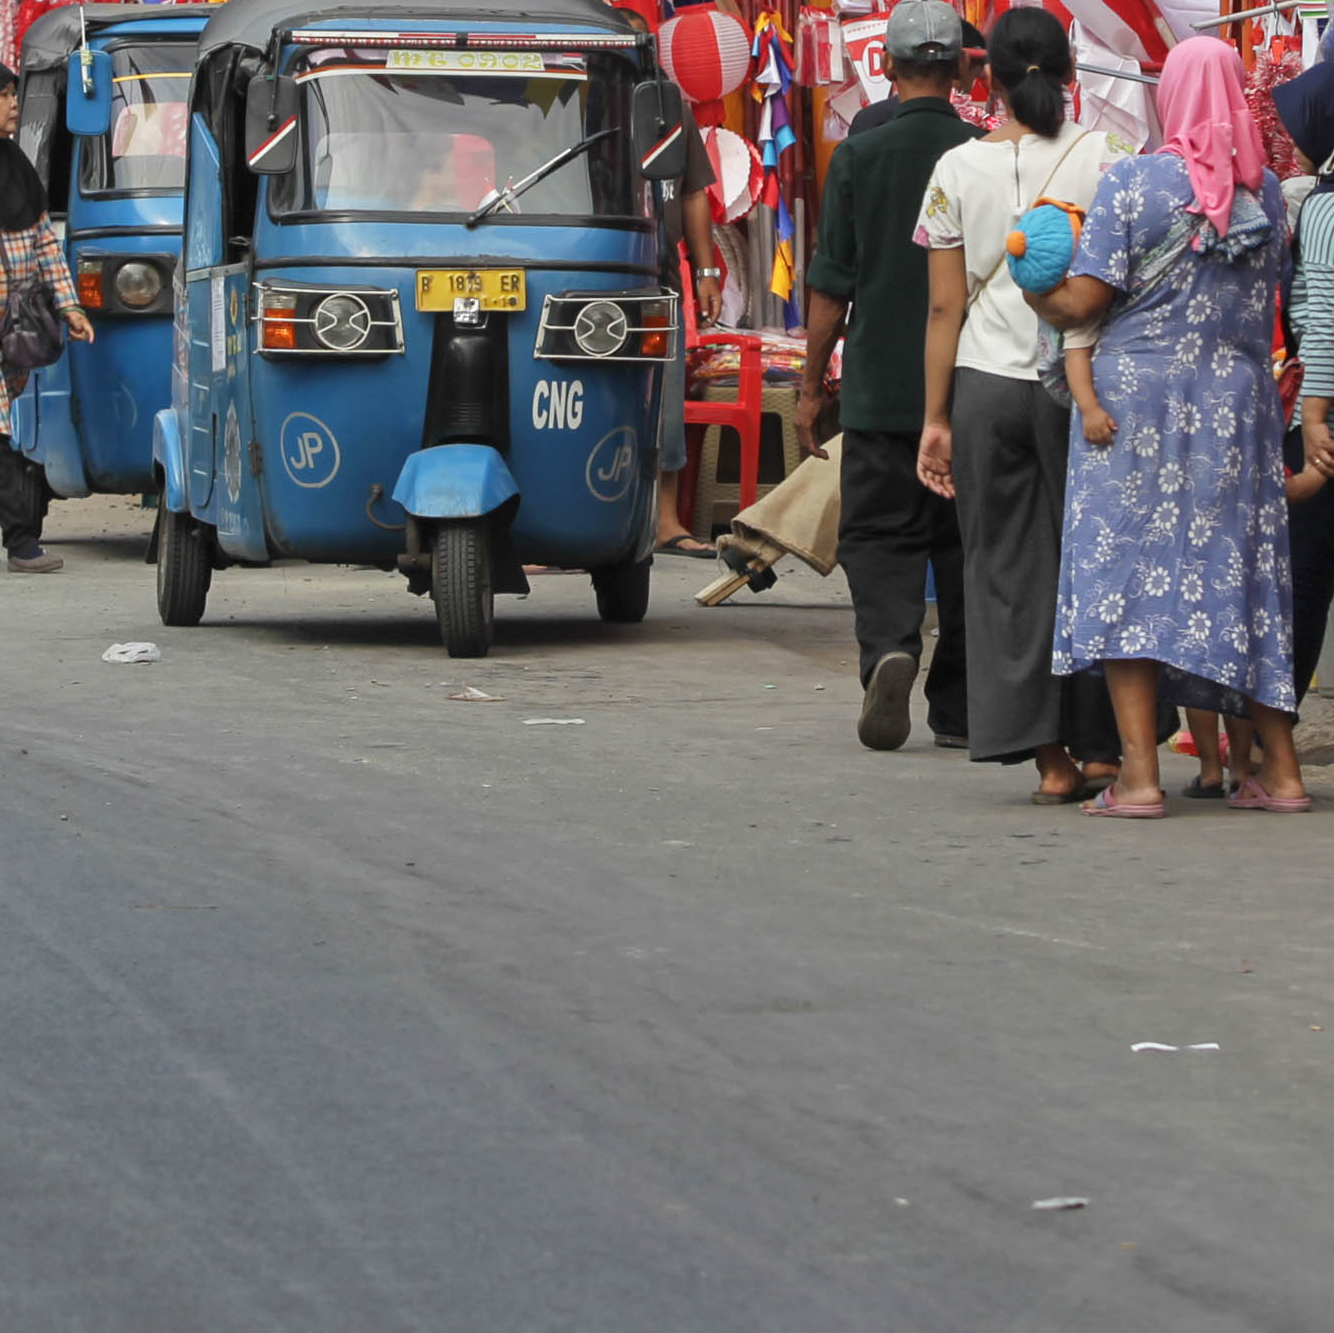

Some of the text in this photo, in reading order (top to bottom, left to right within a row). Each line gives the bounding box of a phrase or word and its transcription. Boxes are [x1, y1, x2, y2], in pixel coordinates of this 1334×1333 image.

[457, 52, 542, 70] 0902
[500, 274, 520, 293] ER
[532, 379, 584, 430] CNG
[290, 432, 323, 470] JP
[597, 445, 632, 482] JP
